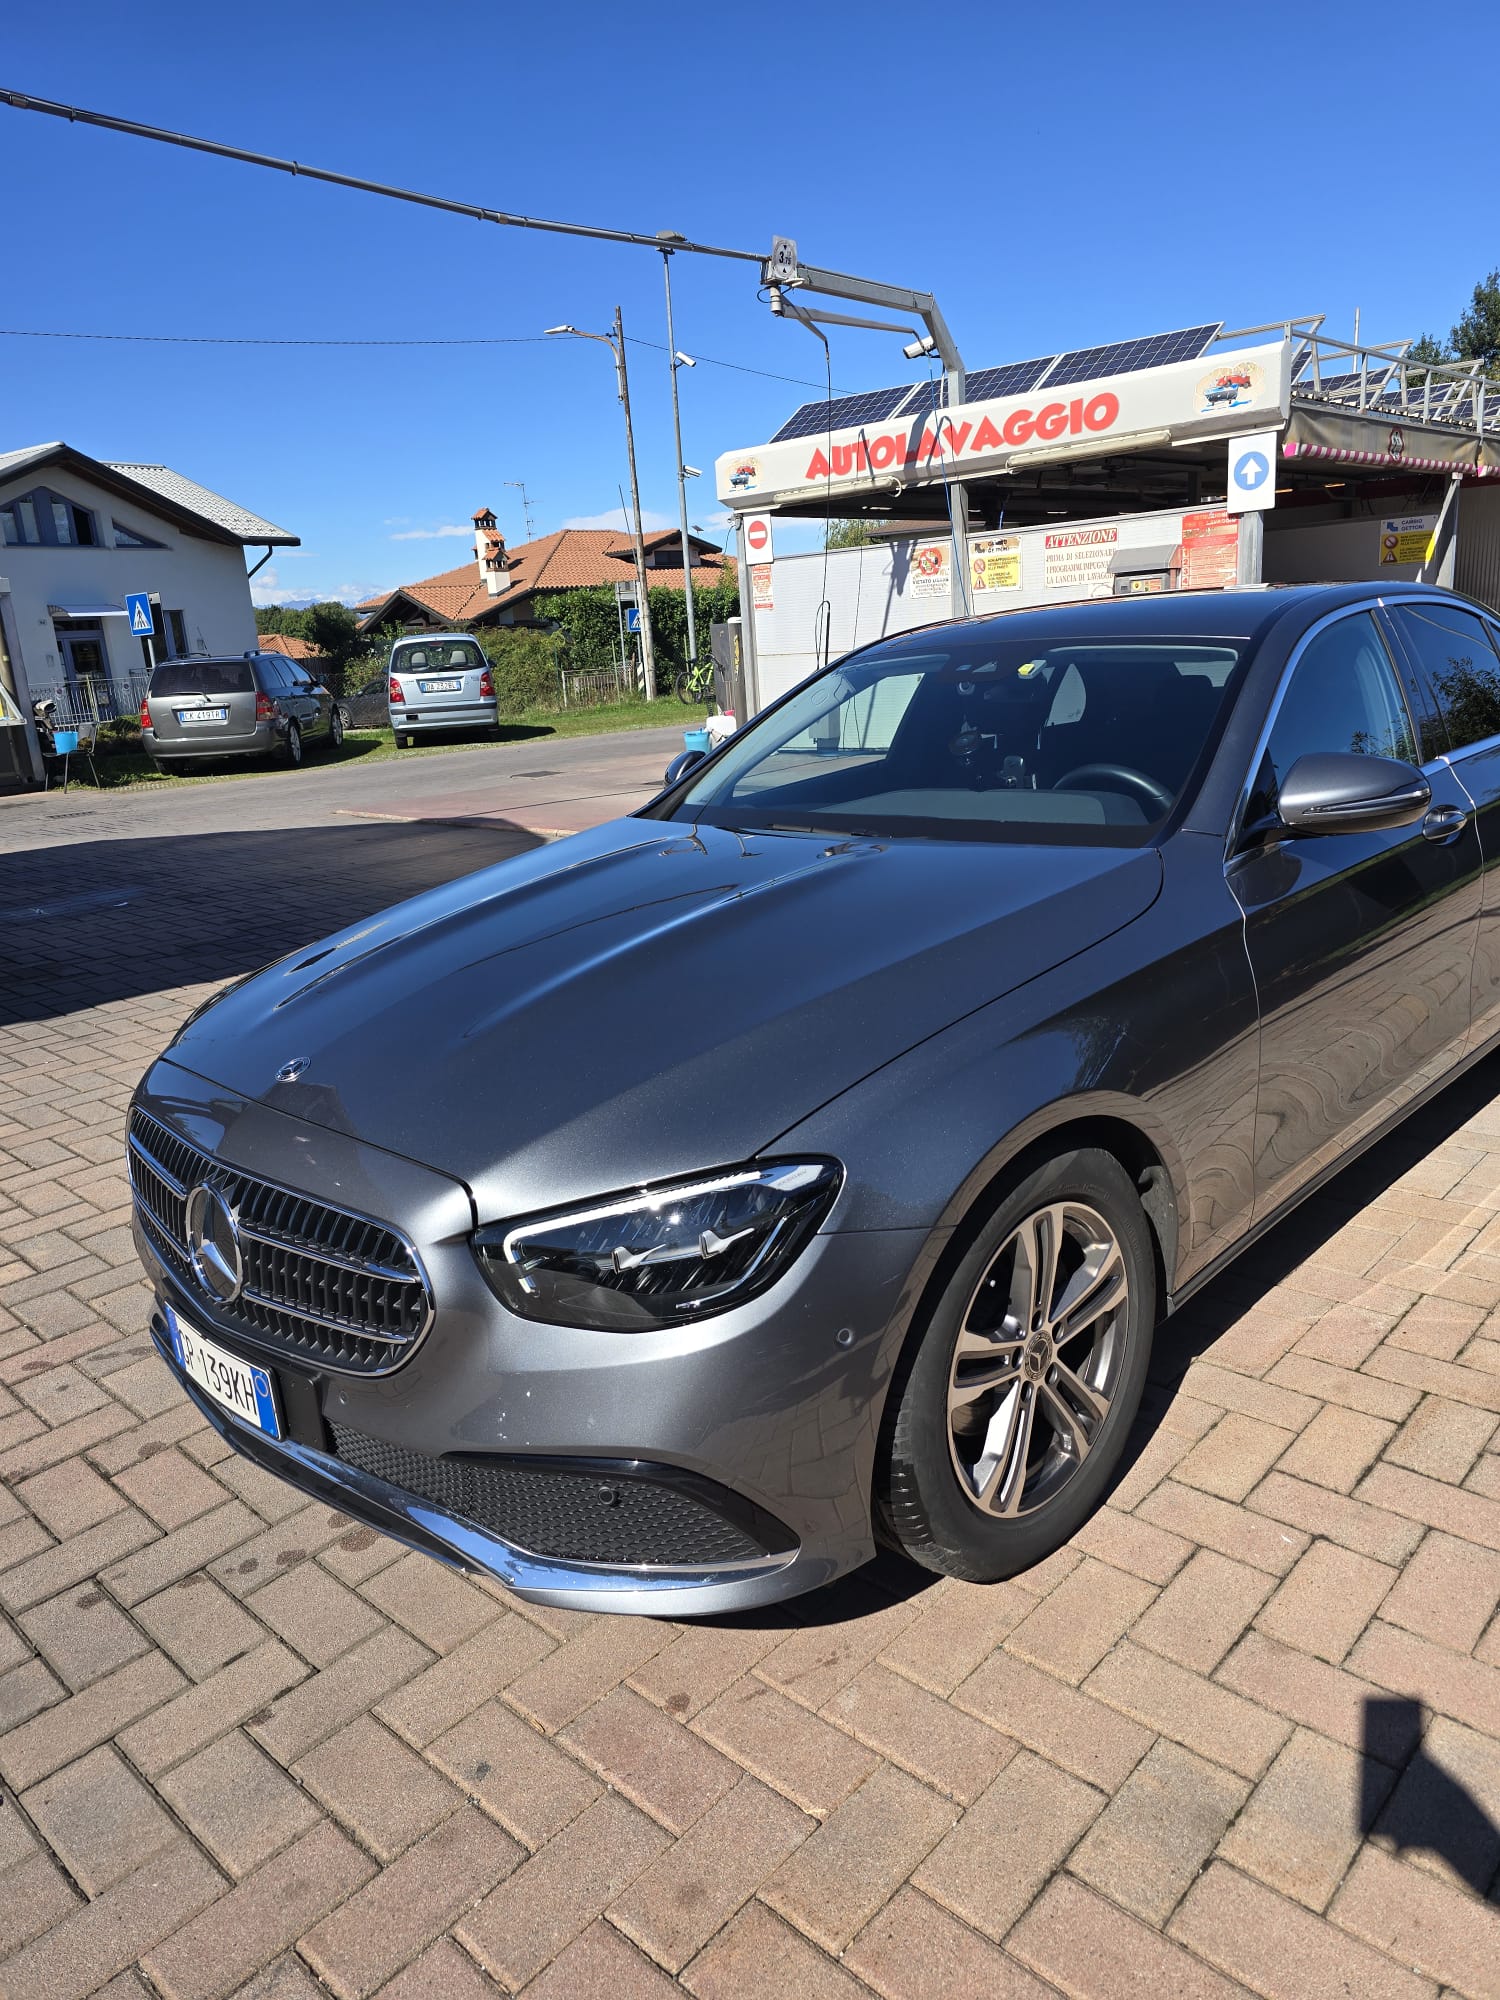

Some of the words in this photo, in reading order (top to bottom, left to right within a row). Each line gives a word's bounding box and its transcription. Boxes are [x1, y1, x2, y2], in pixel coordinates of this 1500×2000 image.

[805, 392, 1120, 480] AUTOLAVAGGIO
[1046, 529, 1116, 549] ATTENZIONE
[1046, 553, 1065, 562] PRIMA
[1066, 552, 1073, 560] DI
[1049, 563, 1082, 574] PROGRAMMI
[1046, 576, 1054, 584] LA
[1055, 574, 1077, 583] LANCIA
[1078, 573, 1085, 581] DI
[199, 1347, 258, 1416] 139KH
